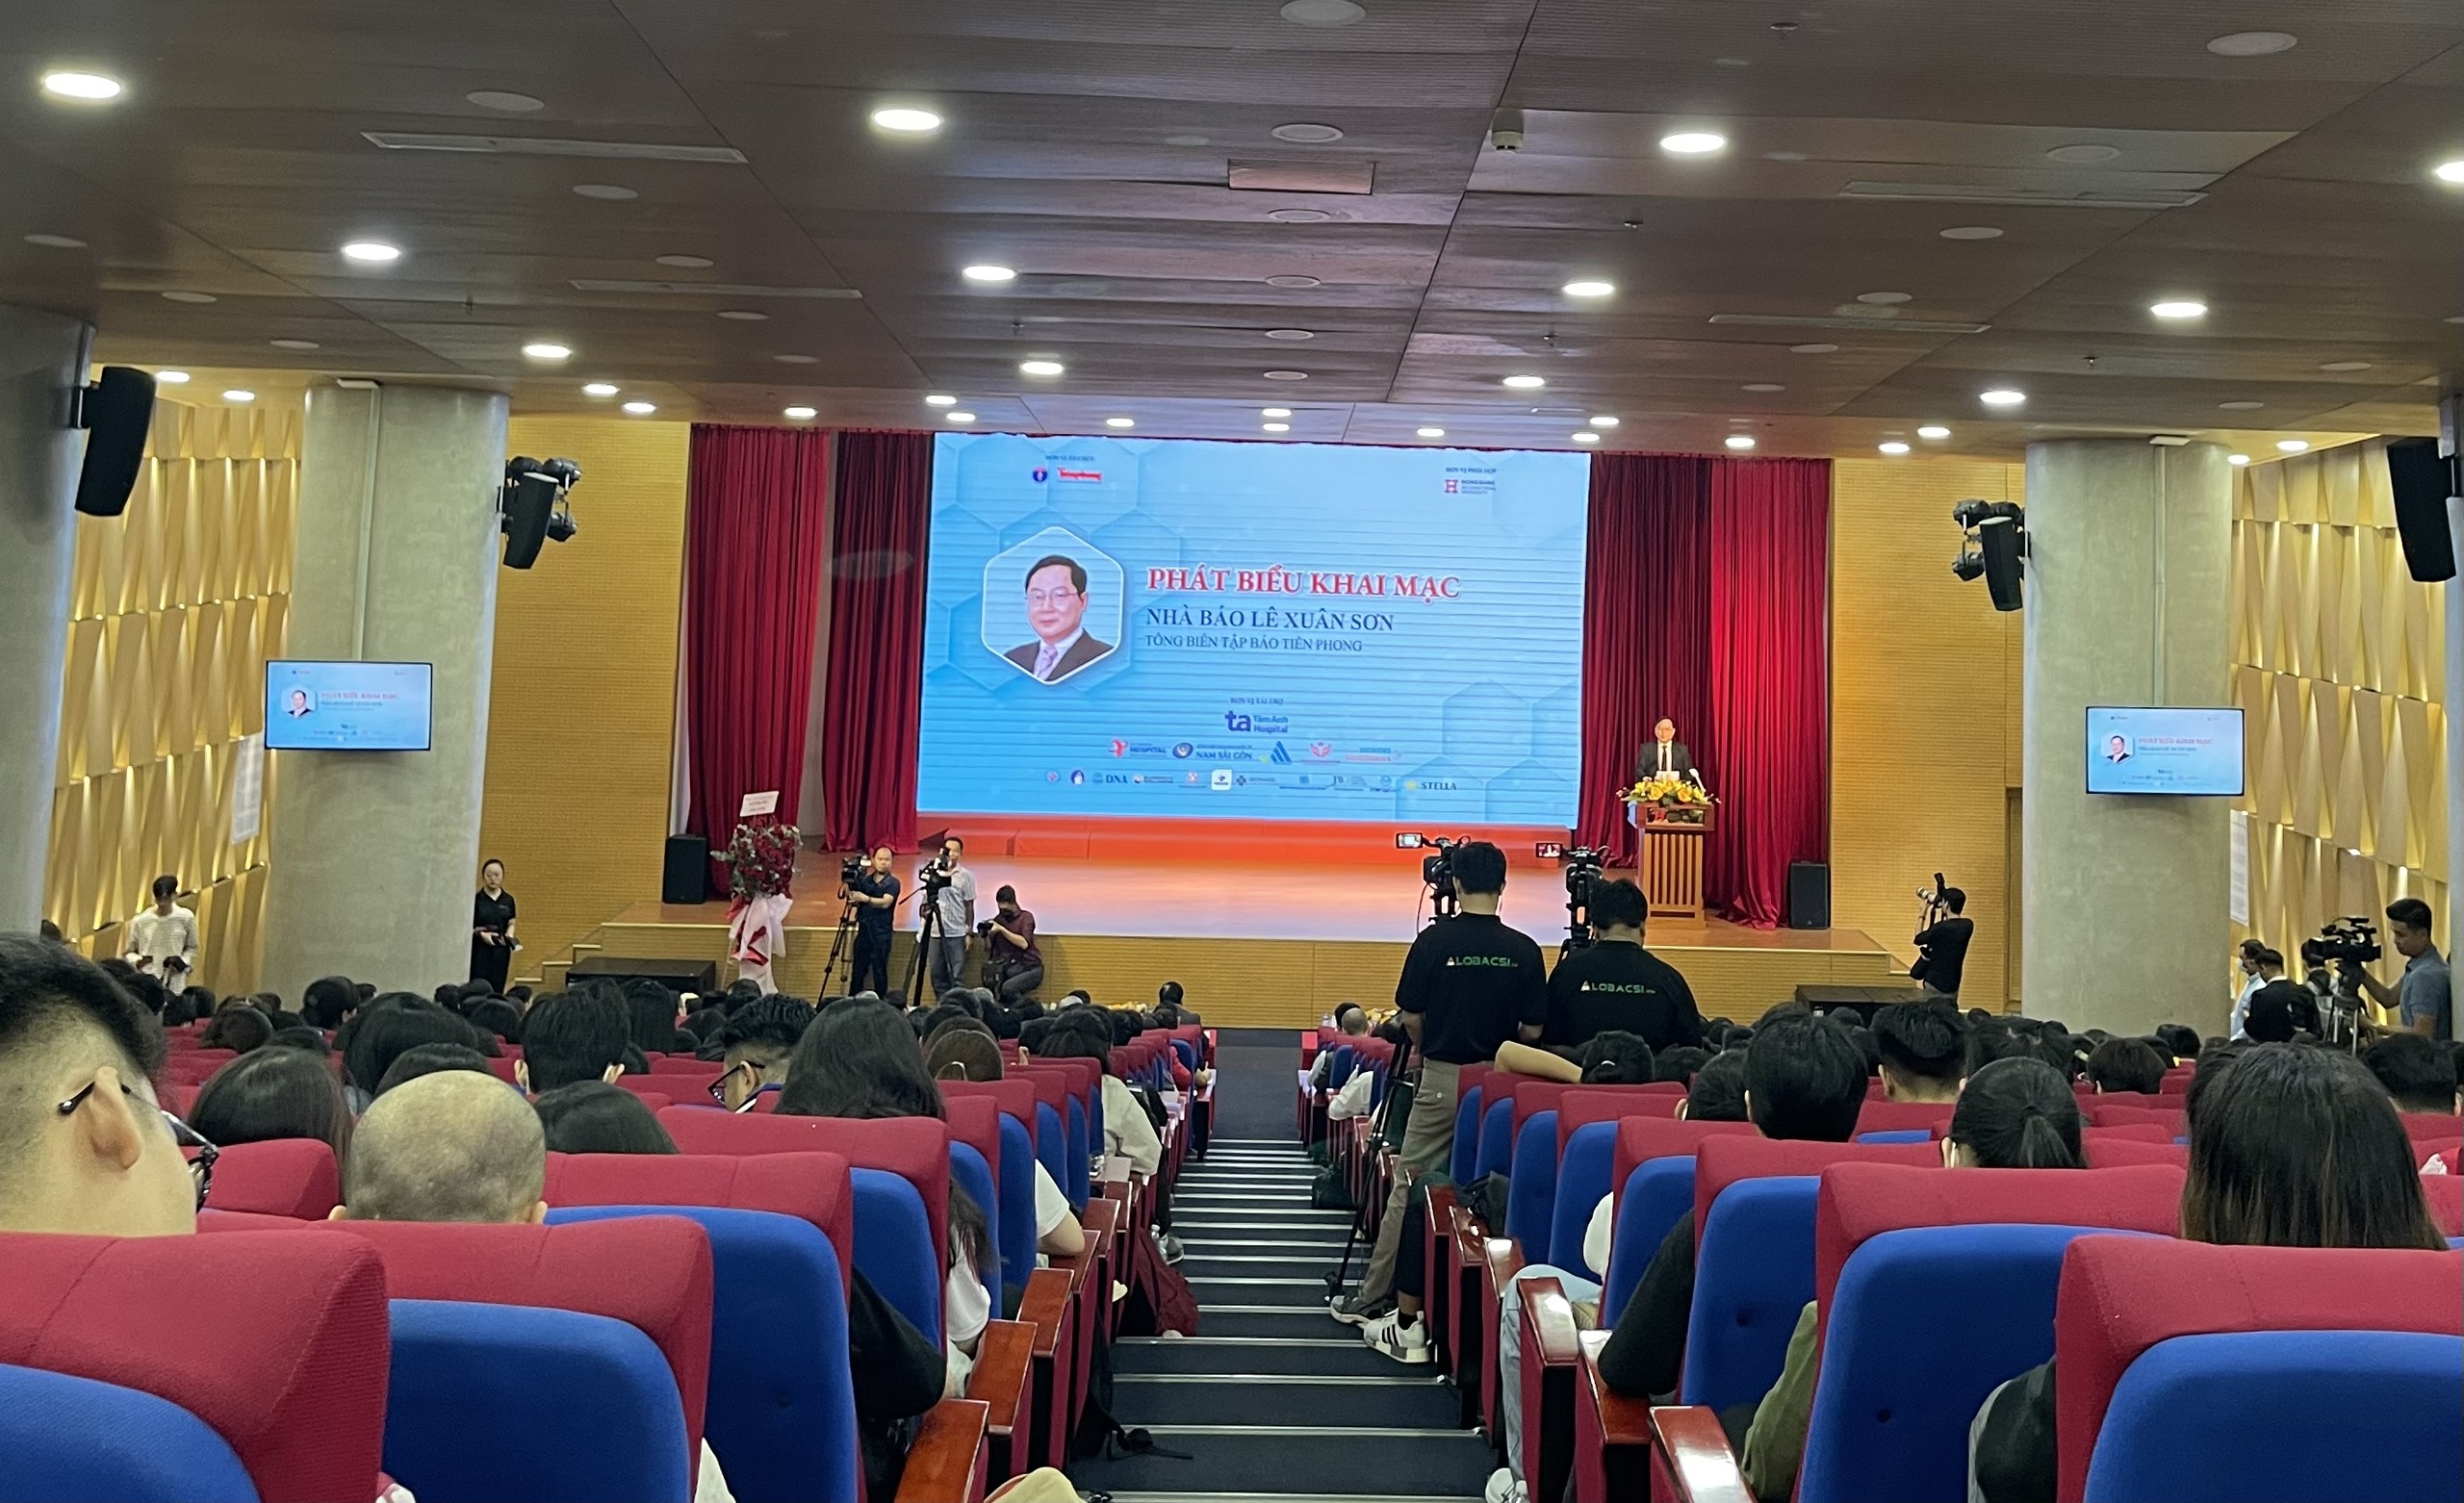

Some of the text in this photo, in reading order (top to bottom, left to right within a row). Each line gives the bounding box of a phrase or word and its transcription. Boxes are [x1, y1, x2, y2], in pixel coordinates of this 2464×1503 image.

[1148, 564, 1231, 591] PHÁT
[1310, 573, 1386, 596] KHAI
[1394, 574, 1461, 604] MẠC
[1146, 604, 1394, 631] NHÀ BÁO LÊ XUÂN SƠN
[1316, 639, 1363, 652] PHONG
[1224, 710, 1251, 732] ta
[1422, 781, 1457, 791] STELLA
